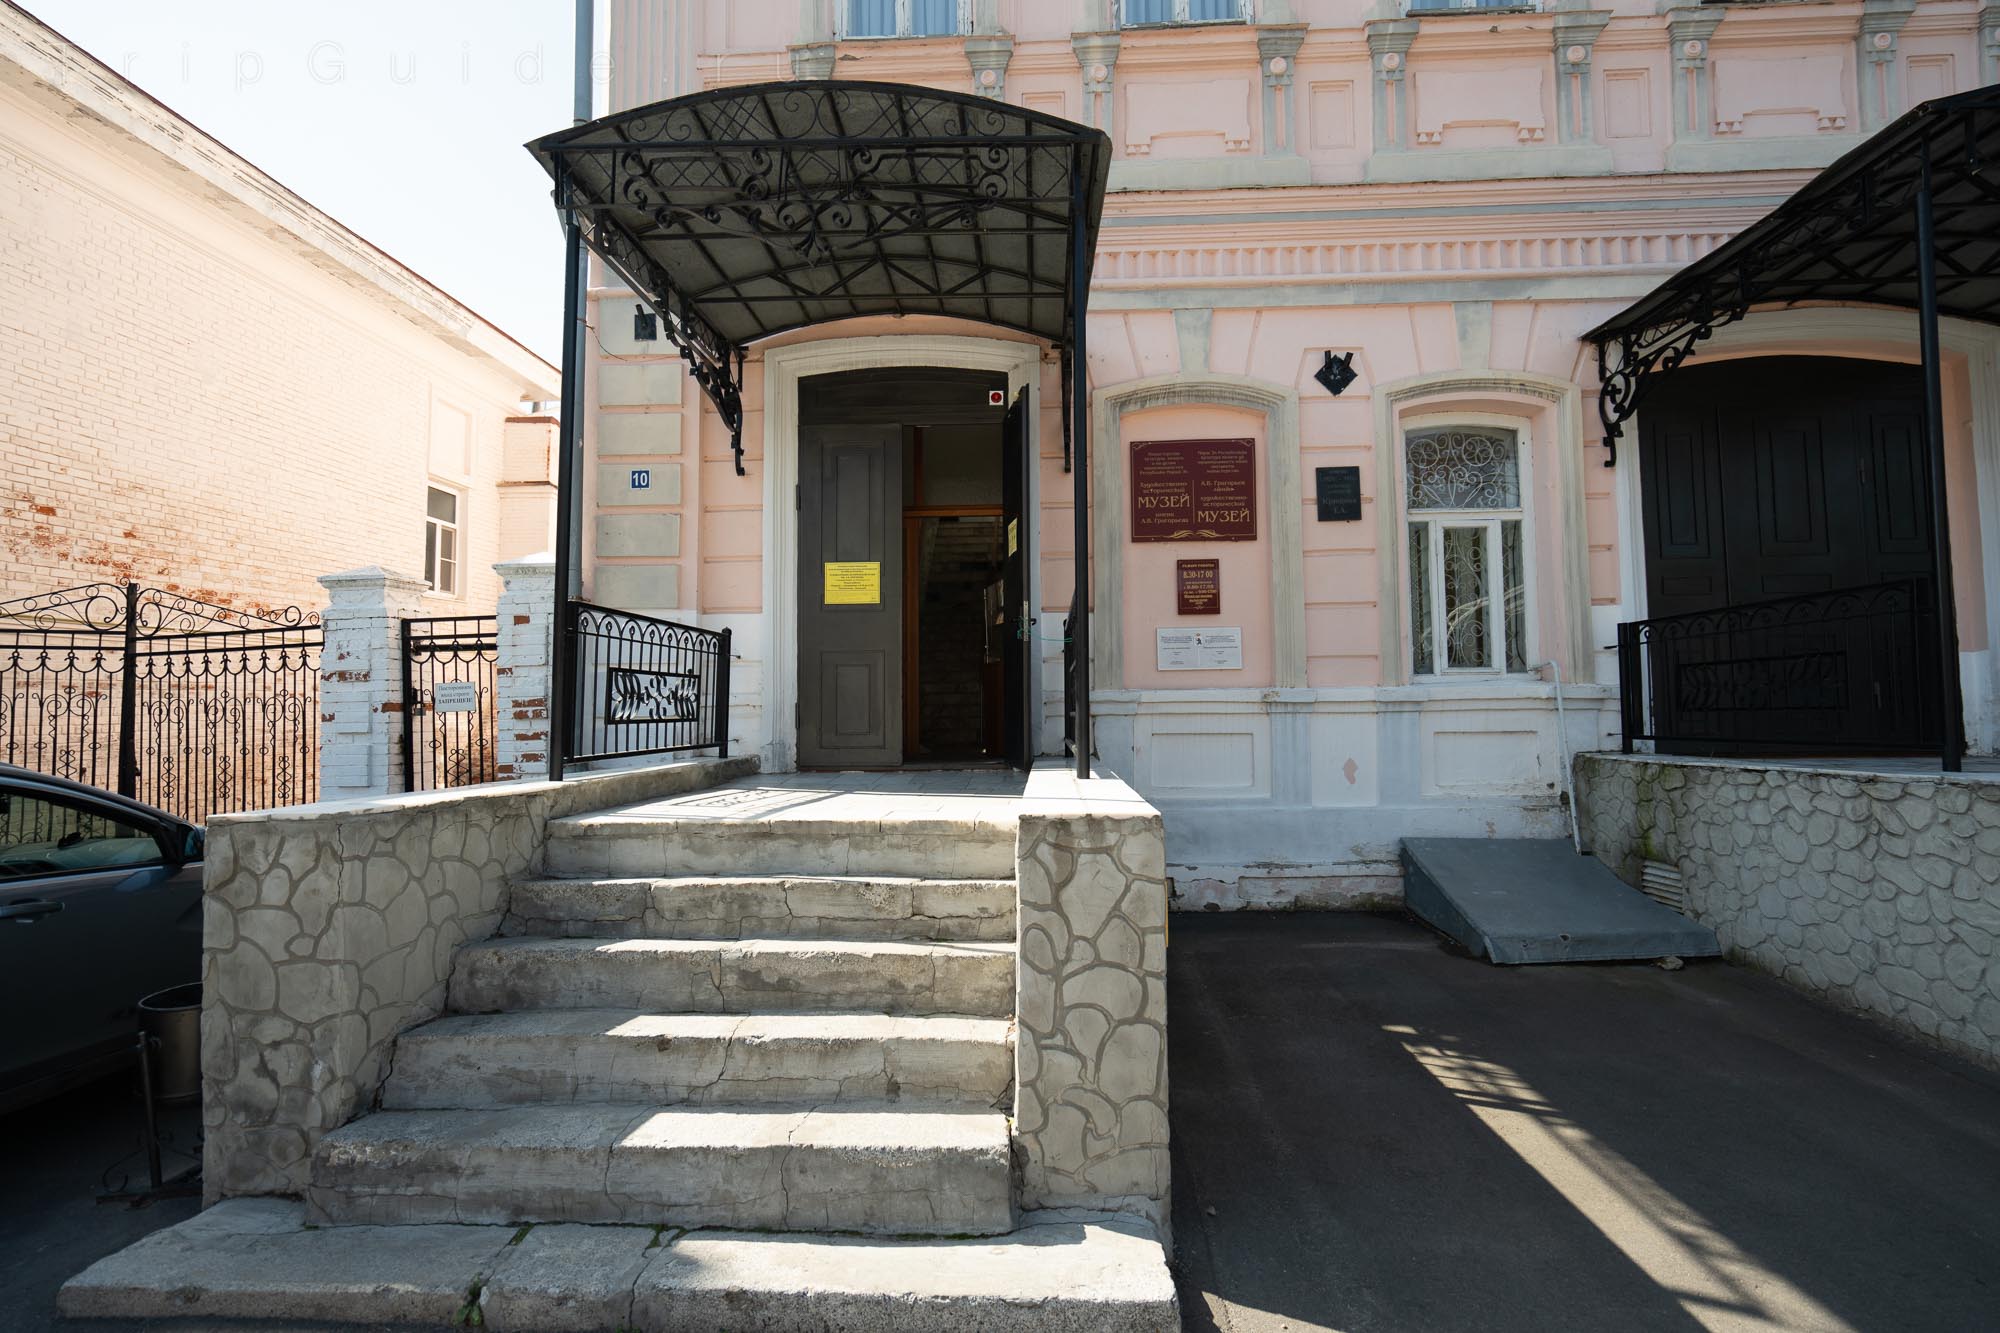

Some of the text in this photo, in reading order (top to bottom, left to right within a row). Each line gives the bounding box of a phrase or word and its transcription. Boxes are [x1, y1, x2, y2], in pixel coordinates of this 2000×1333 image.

[632, 472, 648, 487] 10
[1138, 493, 1190, 509] МУЗЕЙ
[1197, 507, 1251, 523] МУЗЕЙ
